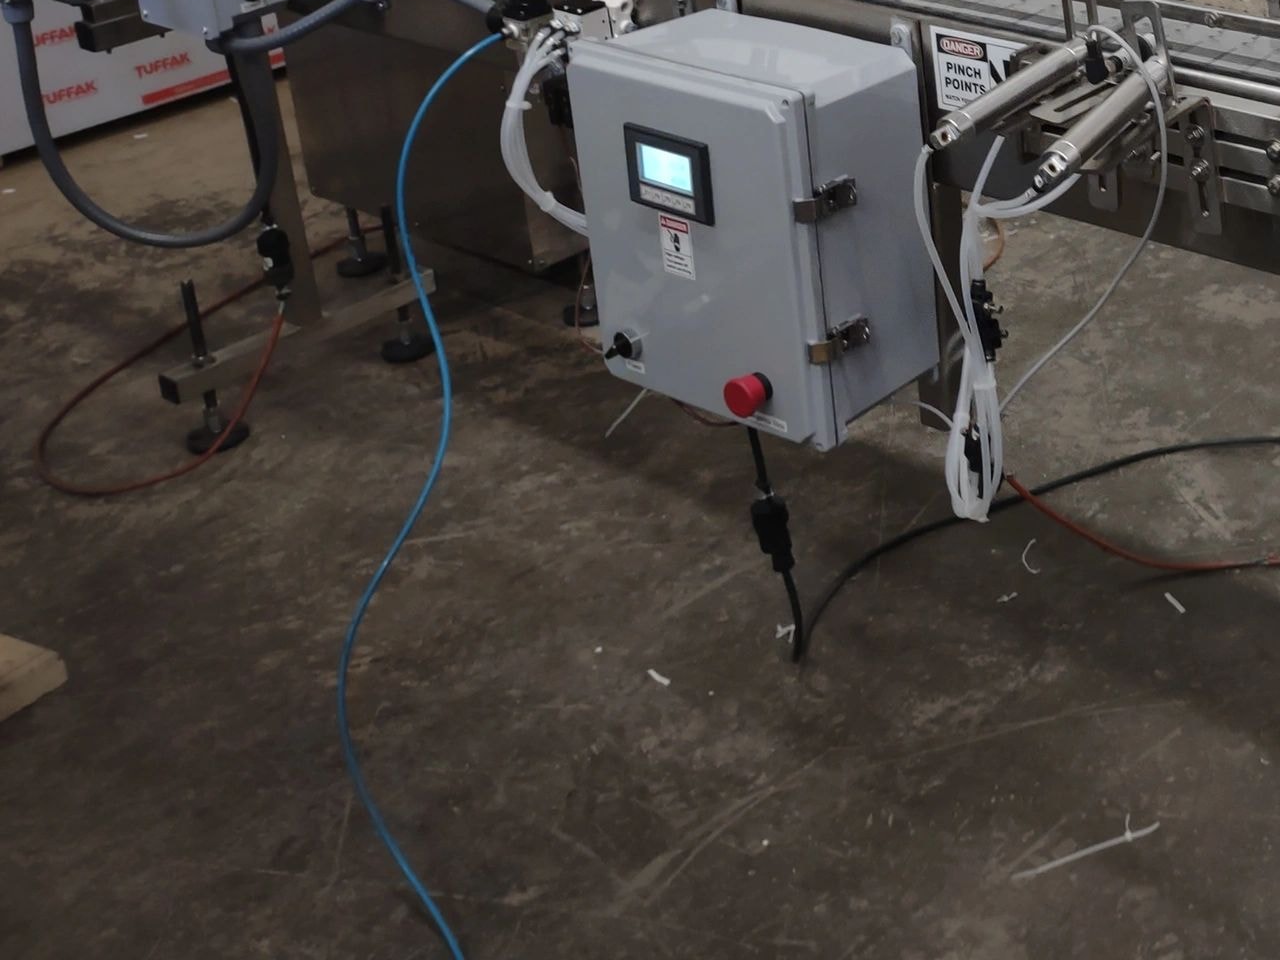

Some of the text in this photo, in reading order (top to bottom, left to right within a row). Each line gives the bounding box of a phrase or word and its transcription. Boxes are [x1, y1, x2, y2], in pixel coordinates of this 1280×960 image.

[942, 40, 981, 57] DANGER
[134, 52, 192, 78] TUFFAK
[946, 61, 982, 80] PINCH
[944, 76, 987, 95] POINTS
